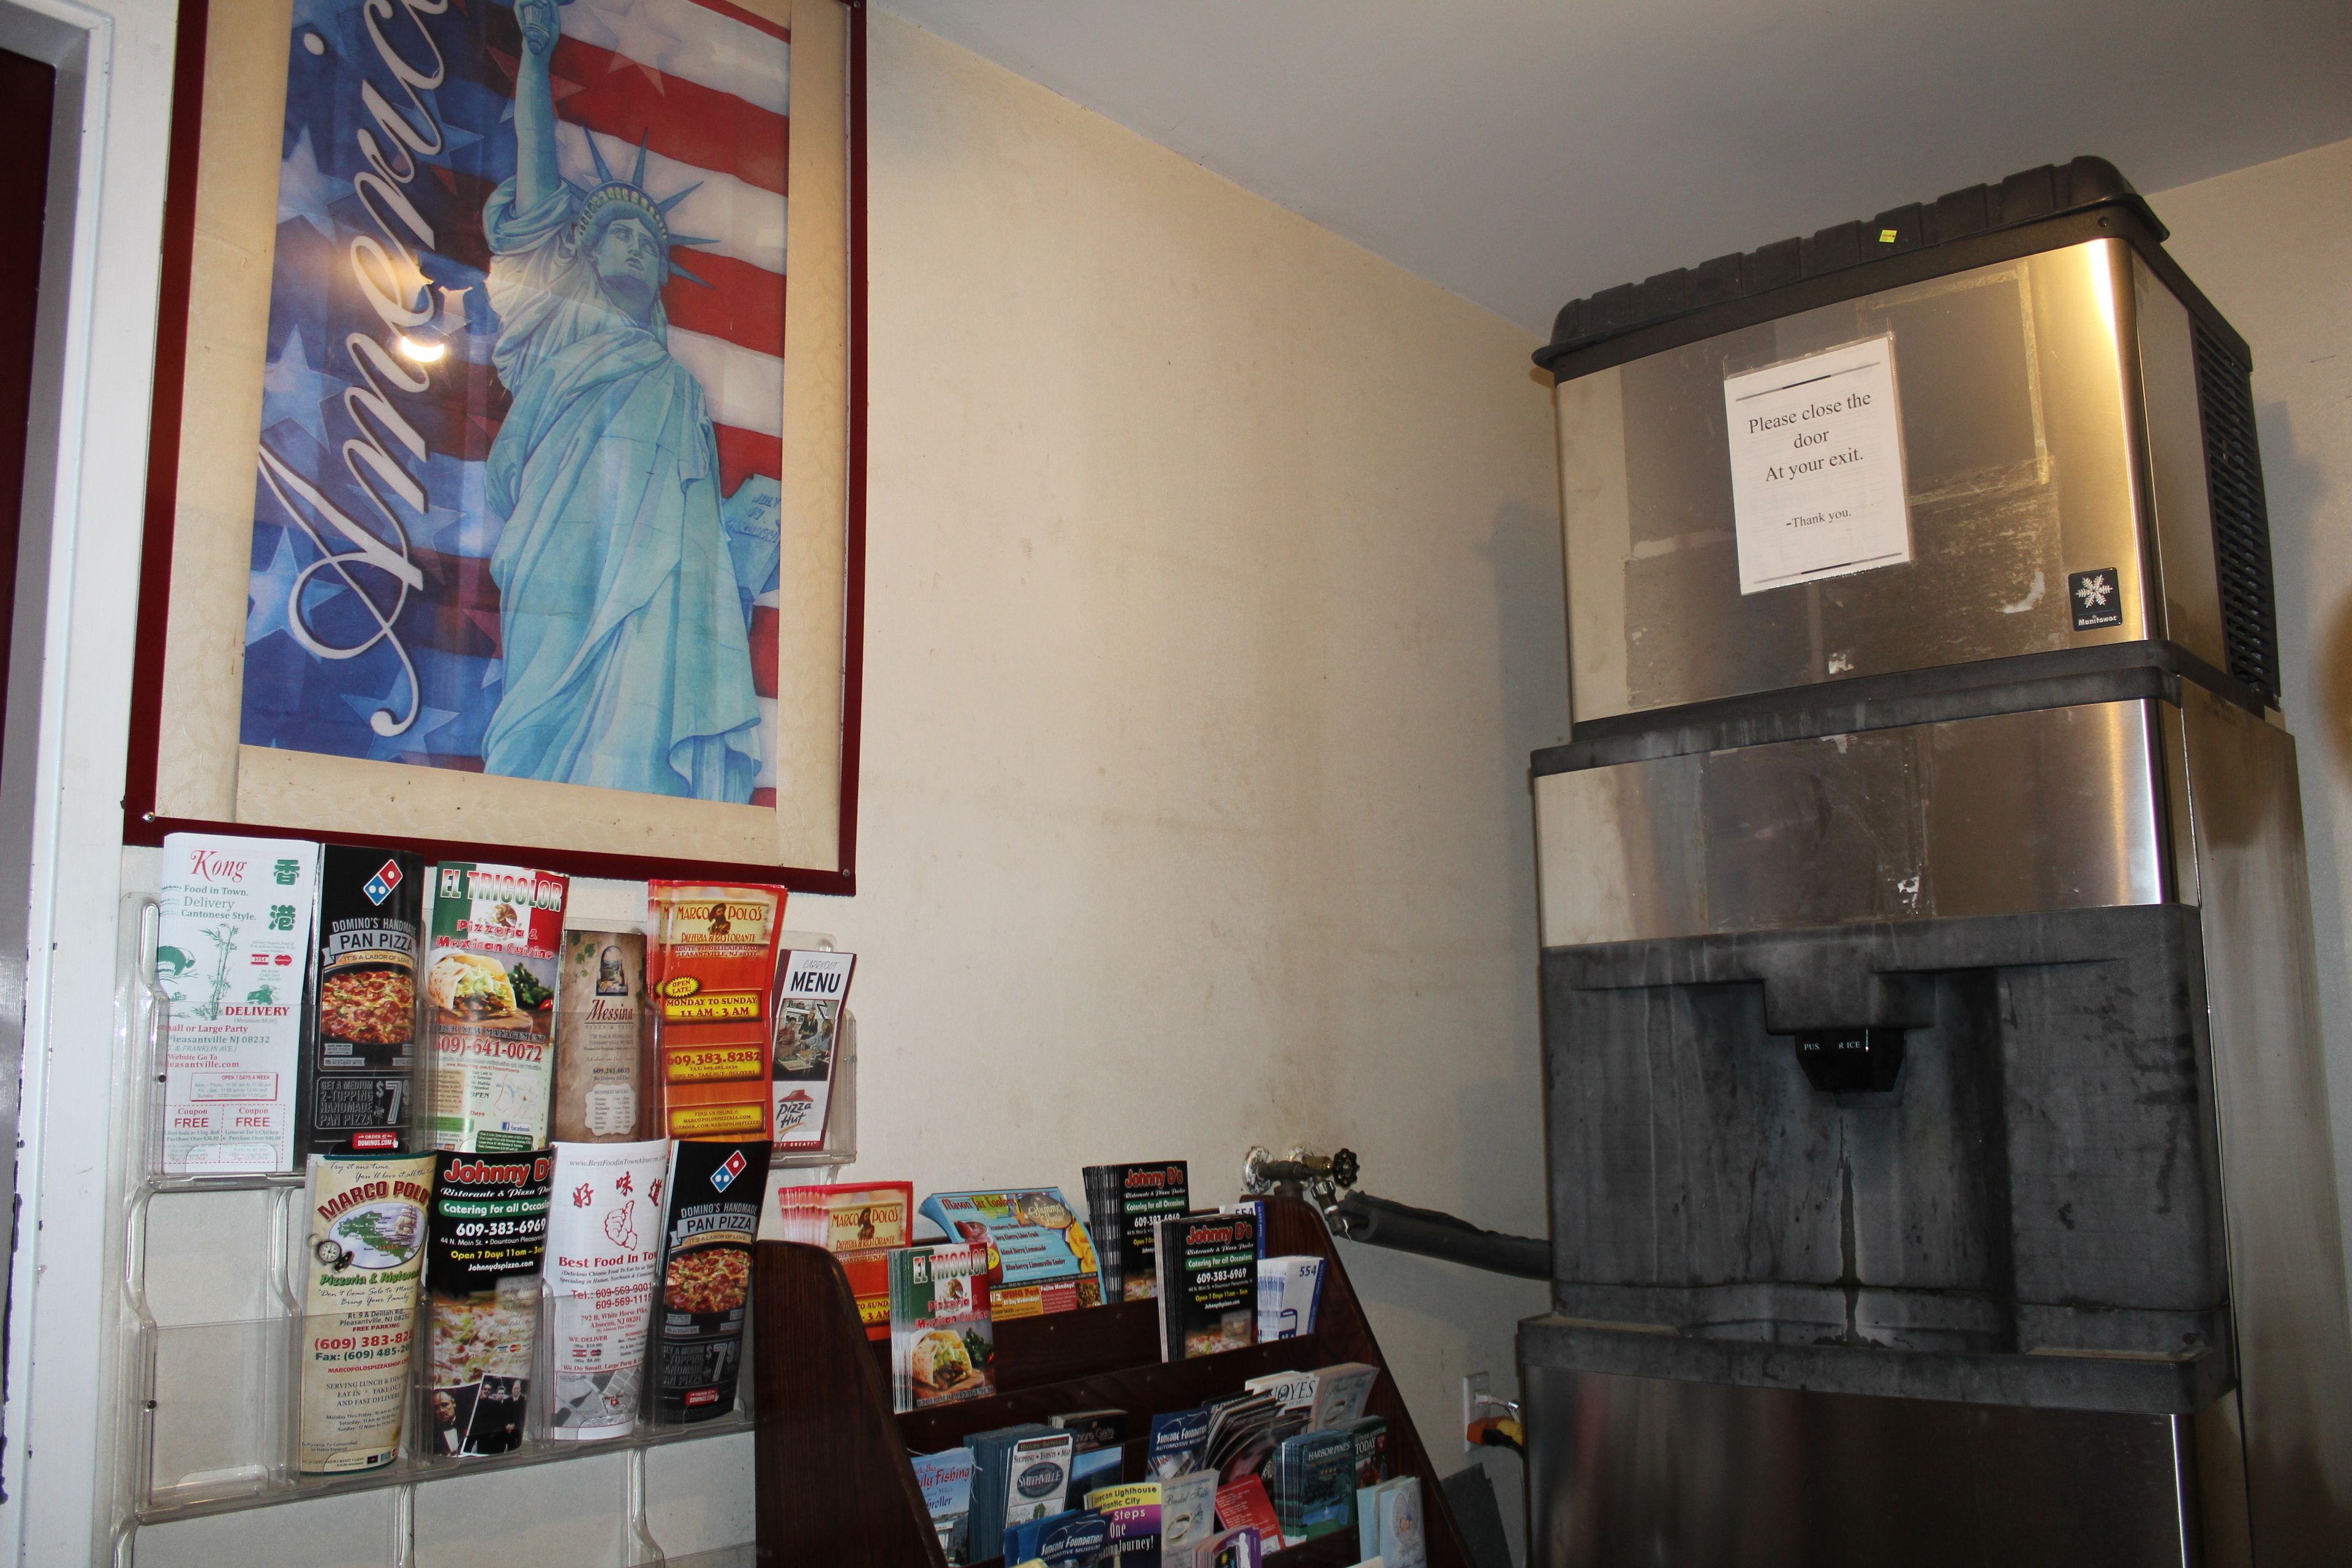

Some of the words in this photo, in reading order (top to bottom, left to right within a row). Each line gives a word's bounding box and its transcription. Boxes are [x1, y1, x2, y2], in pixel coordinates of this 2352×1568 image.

[258, 0, 449, 736] Americ
[1749, 412, 1796, 434] Please
[1802, 402, 1842, 421] close
[1847, 393, 1872, 410] the
[1793, 430, 1829, 448] door
[1765, 465, 1784, 482] At
[1789, 458, 1825, 480] your
[1829, 447, 1864, 467] exit.
[1786, 513, 1825, 529] -Thank
[1828, 509, 1852, 524] you.
[2078, 616, 2117, 626] Manitowoc
[190, 850, 247, 883] Kong
[184, 885, 207, 894] Food
[222, 888, 249, 896] Town.
[440, 869, 461, 899] EL
[467, 870, 563, 913] TRICOLOR
[184, 896, 235, 911] Delivery
[181, 910, 230, 919] Cantonese
[232, 912, 257, 922] Style.
[676, 907, 709, 920] MARCO
[728, 906, 762, 921] POLO'S
[333, 918, 379, 932] DOMINO'S
[457, 919, 524, 938] Pizzeria
[341, 933, 372, 949] PAN
[380, 933, 412, 950] PIZZA
[682, 933, 706, 943] PIZZERIA
[715, 933, 756, 943] RISTORANTE
[436, 935, 503, 952] Mexican
[507, 943, 554, 960] Cuisine
[803, 960, 840, 970] CARRYOUT
[790, 971, 841, 993] MENU
[673, 986, 692, 994] LATE!
[223, 1006, 290, 1016] DELIVERY
[586, 999, 633, 1020] Messina
[732, 1007, 749, 1016] AM
[167, 1035, 228, 1044] Pleasantville
[666, 1050, 761, 1066] 609.383.8282
[322, 1081, 335, 1090] GET
[344, 1080, 373, 1090] MEDIUM
[320, 1091, 373, 1101] 2-TOPPING
[320, 1102, 372, 1113] HANDMADE
[175, 1118, 209, 1127] FREE
[236, 1117, 270, 1126] FREE
[320, 1114, 341, 1126] PAN
[343, 1114, 372, 1126] PIZZA
[780, 1113, 806, 1128] Hut
[444, 1158, 530, 1187] Johnny
[1125, 1169, 1166, 1189] Johnny
[1167, 1166, 1183, 1185] D's
[440, 1188, 494, 1197] Ristorante
[508, 1189, 535, 1197] Pizza
[317, 1181, 388, 1221] MARCO
[941, 1198, 973, 1210] Mason
[971, 1197, 986, 1210] Jar
[1126, 1203, 1147, 1212] Catering
[444, 1202, 487, 1216] Catering
[490, 1204, 504, 1213] for
[506, 1203, 519, 1213] all
[681, 1203, 720, 1218] DOMINO'S
[724, 1203, 758, 1215] HANDMADE
[687, 1217, 714, 1233] PAN
[719, 1216, 751, 1230] PIZZA
[832, 1213, 859, 1228] MARCO
[872, 1207, 898, 1223] POLO'S
[456, 1218, 546, 1236] 609-383-6969
[1186, 1224, 1233, 1245] Johnny
[1235, 1221, 1253, 1240] D's
[451, 1251, 475, 1261] Open
[484, 1250, 503, 1259] Days
[559, 1256, 589, 1268] Best
[594, 1255, 624, 1267] Food
[627, 1254, 638, 1263] In
[1188, 1259, 1211, 1268] Catering
[1229, 1254, 1253, 1263] Occasions
[468, 1261, 533, 1272] Johnnydspizza.com
[913, 1256, 927, 1284] EL
[929, 1249, 987, 1281] TRICOLOR
[1006, 1262, 1028, 1271] Blueberry
[1030, 1260, 1052, 1268] Limoncello
[1299, 1265, 1317, 1277] 554
[320, 1274, 367, 1286] Pizzeria
[1196, 1267, 1246, 1284] 609-383-6969
[596, 1282, 652, 1298] 609-569-9001
[596, 1293, 652, 1309] 609-569-1115
[928, 1298, 969, 1311] Pizzeria
[340, 1317, 383, 1326] Pleasantville,
[371, 1322, 400, 1331] PARKING
[915, 1314, 957, 1329] Mexican
[314, 1338, 356, 1351] (609)
[315, 1352, 341, 1361] Fax:
[344, 1351, 374, 1362] (609)
[1156, 1441, 1188, 1451] AUTOMOTIVE
[1308, 1447, 1333, 1461] HARBOR
[1334, 1441, 1350, 1455] PINES
[1355, 1437, 1376, 1455] TODAY
[1041, 1451, 1056, 1460] EVENTS
[935, 1467, 970, 1486] Fishing
[1019, 1470, 1061, 1488] SMITHVILLE
[1115, 1486, 1156, 1497] Lighthouse
[1114, 1509, 1145, 1521] Steps
[1110, 1522, 1126, 1539] One
[1118, 1535, 1153, 1552] Journey!
